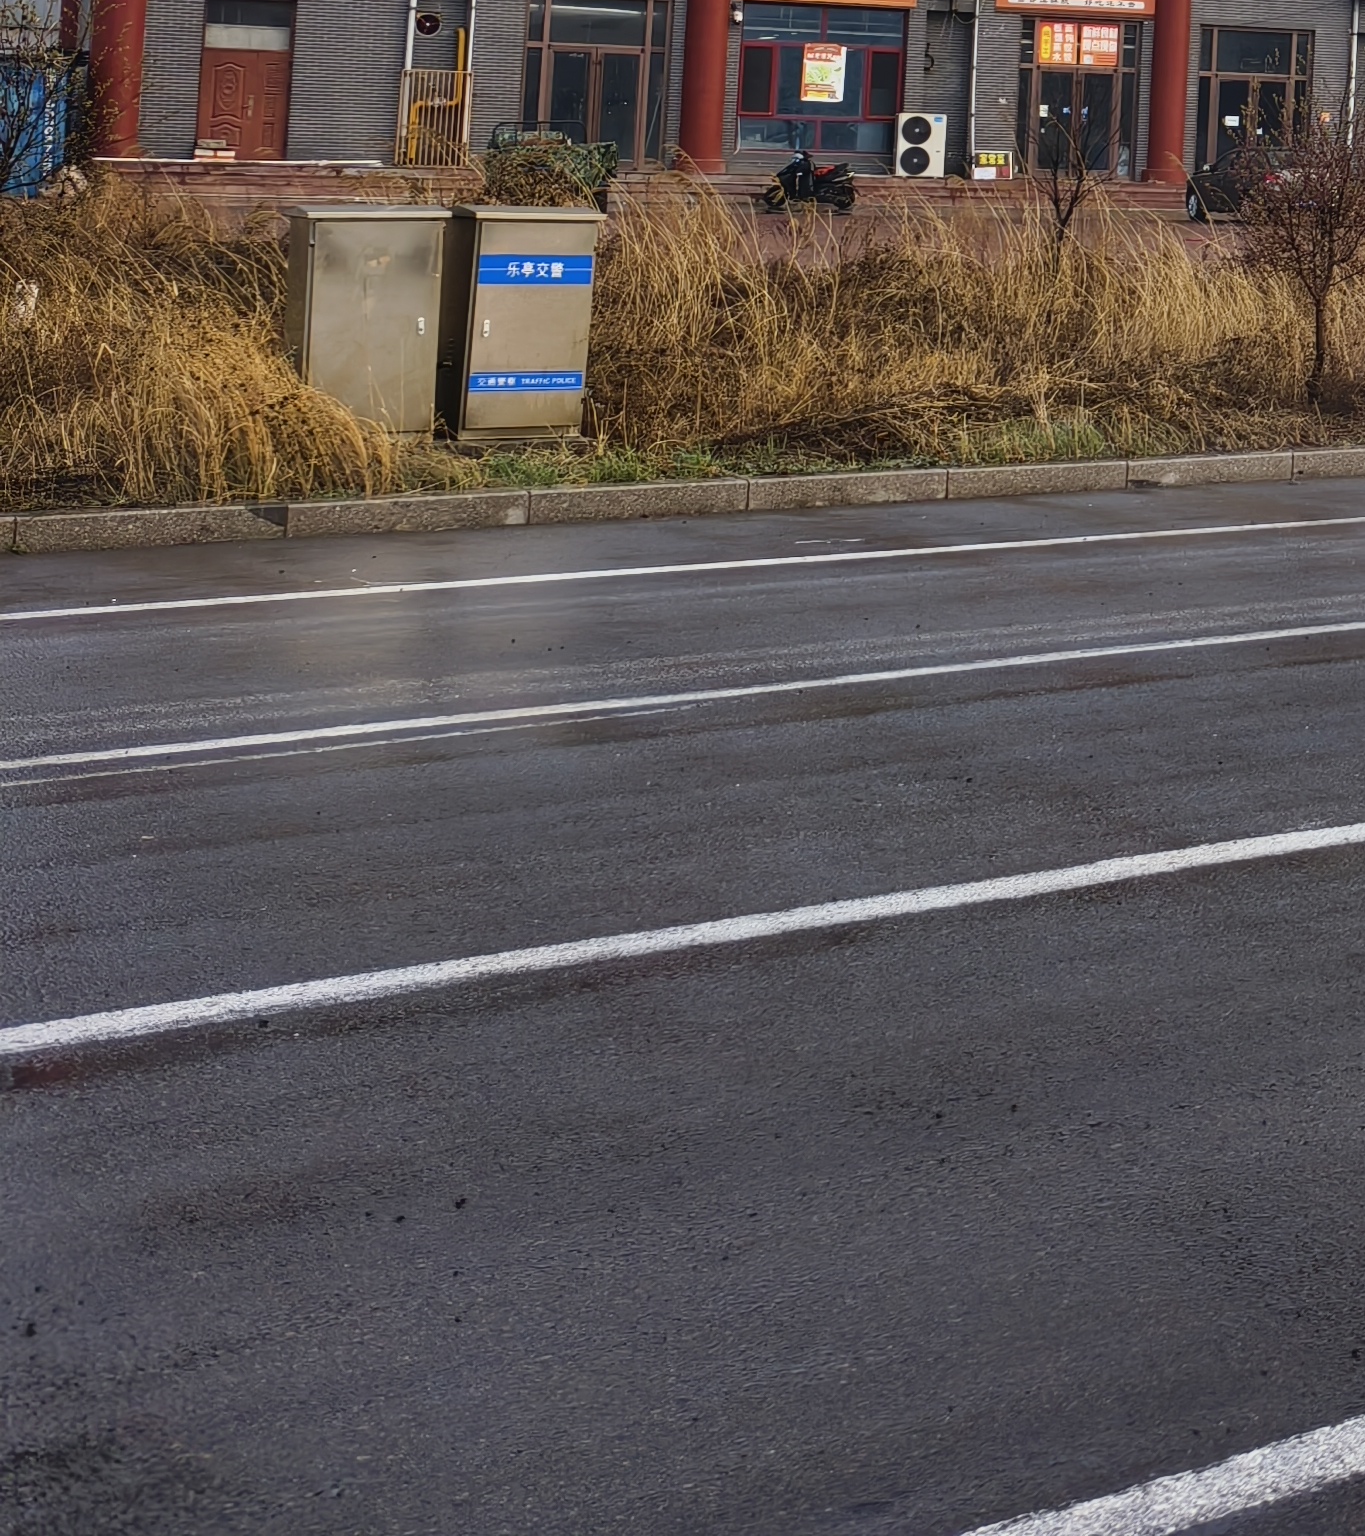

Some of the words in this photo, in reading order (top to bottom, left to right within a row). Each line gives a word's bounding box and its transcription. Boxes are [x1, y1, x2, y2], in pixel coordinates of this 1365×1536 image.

[506, 261, 565, 278] 乐亭交警
[521, 377, 551, 385] TRAFFIC
